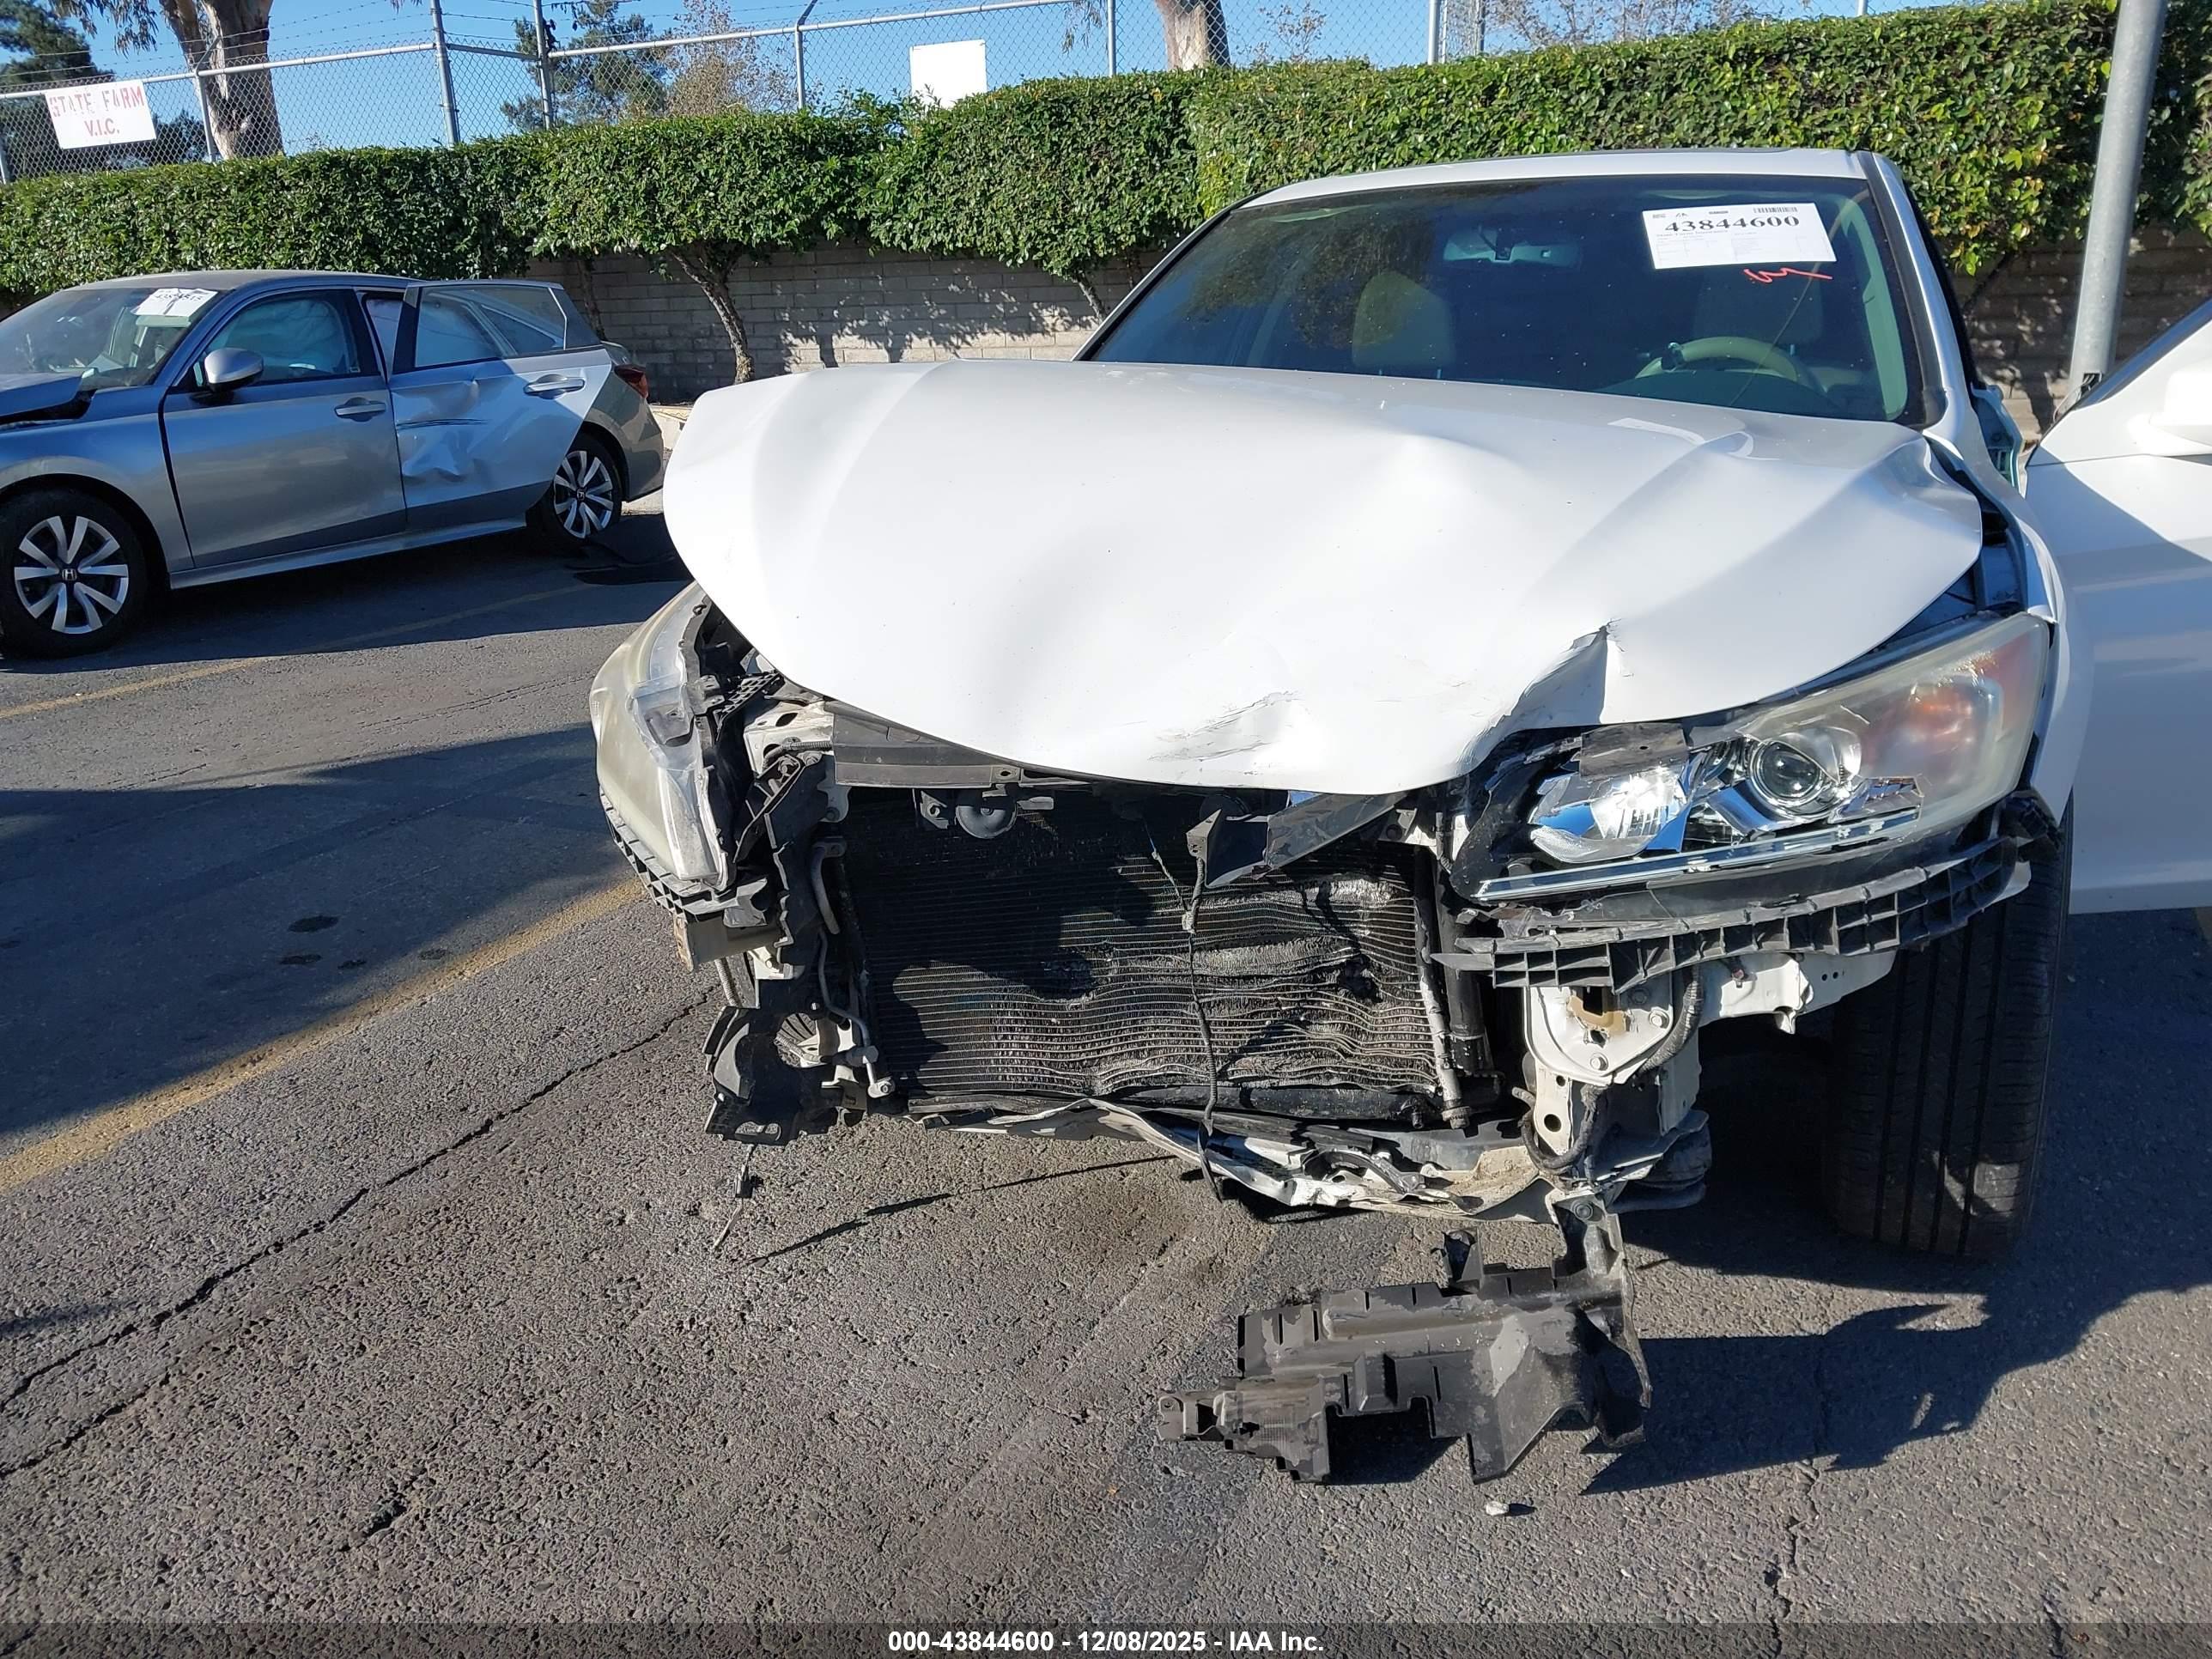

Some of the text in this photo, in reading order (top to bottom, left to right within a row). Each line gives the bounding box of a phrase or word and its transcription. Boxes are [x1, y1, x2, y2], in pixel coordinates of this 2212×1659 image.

[49, 86, 145, 118] STATE FARM
[84, 118, 120, 137] V.I.C.
[1665, 216, 1800, 232] 43844600
